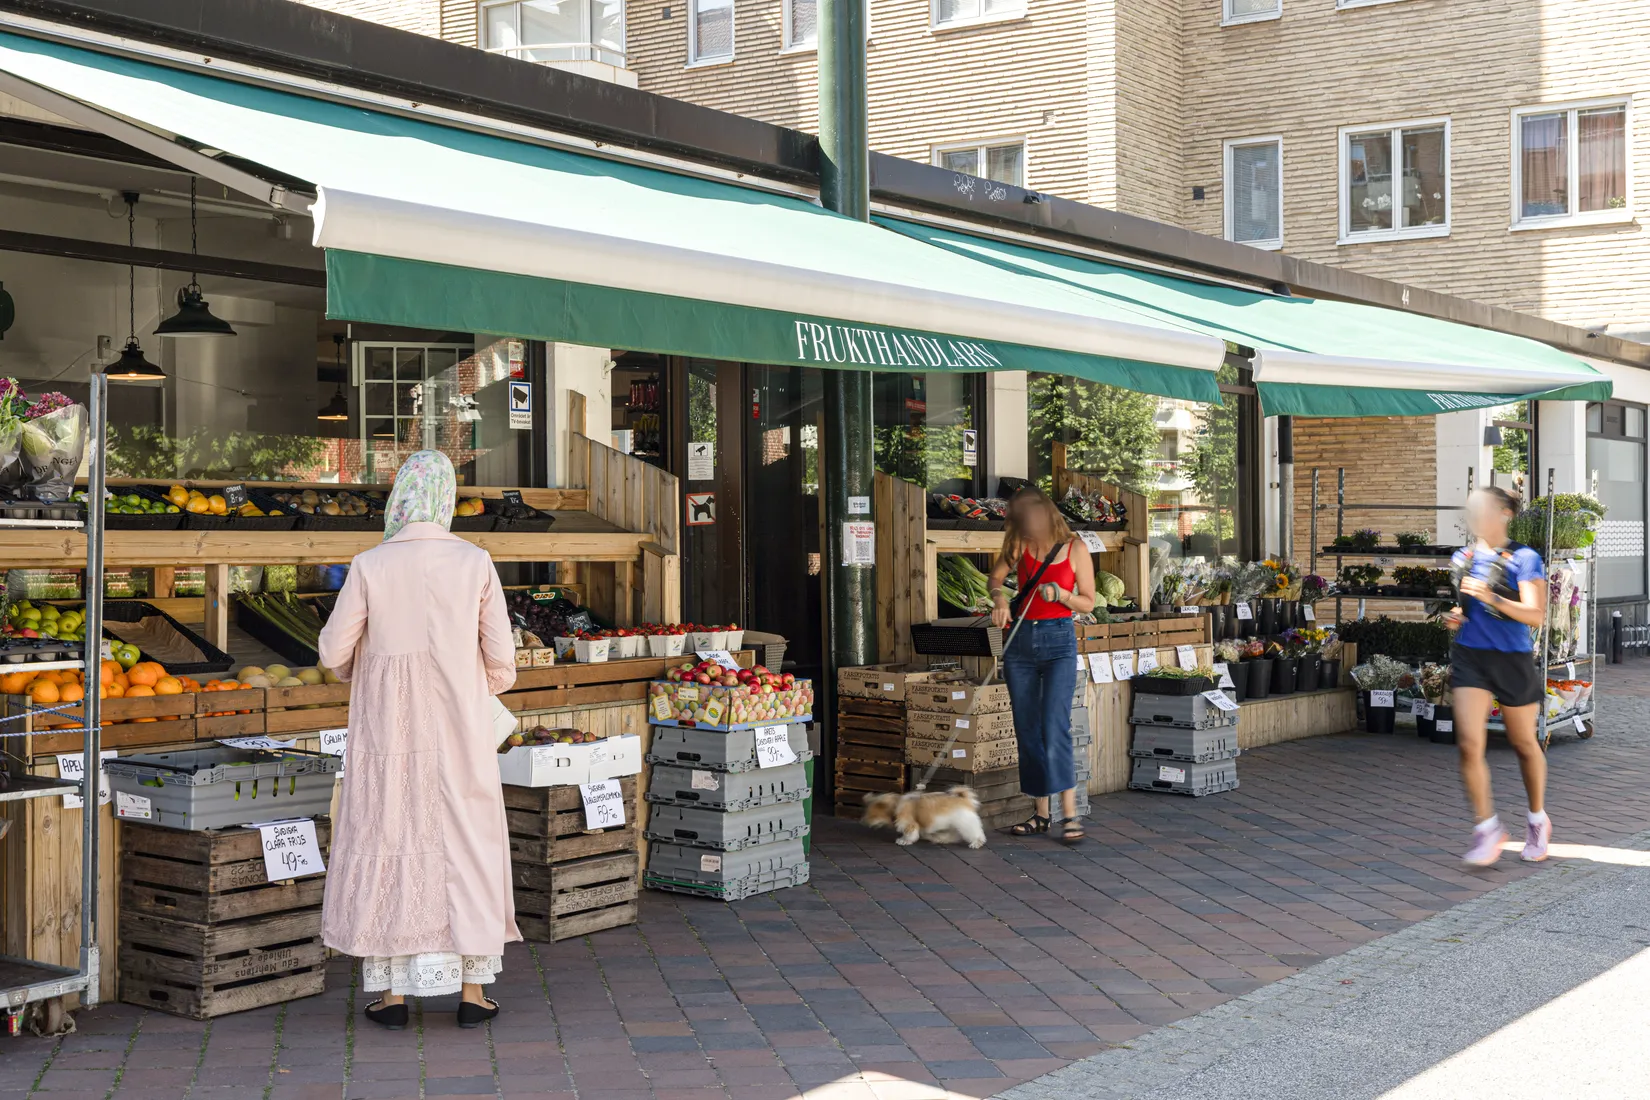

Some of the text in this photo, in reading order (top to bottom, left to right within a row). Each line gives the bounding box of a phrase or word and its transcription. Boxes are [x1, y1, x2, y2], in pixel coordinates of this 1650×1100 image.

[794, 320, 1003, 368] FRUKTHANDLARN
[265, 839, 286, 851] CLARA
[234, 957, 300, 978] Edu Mehrtens
[242, 956, 253, 967] 23
